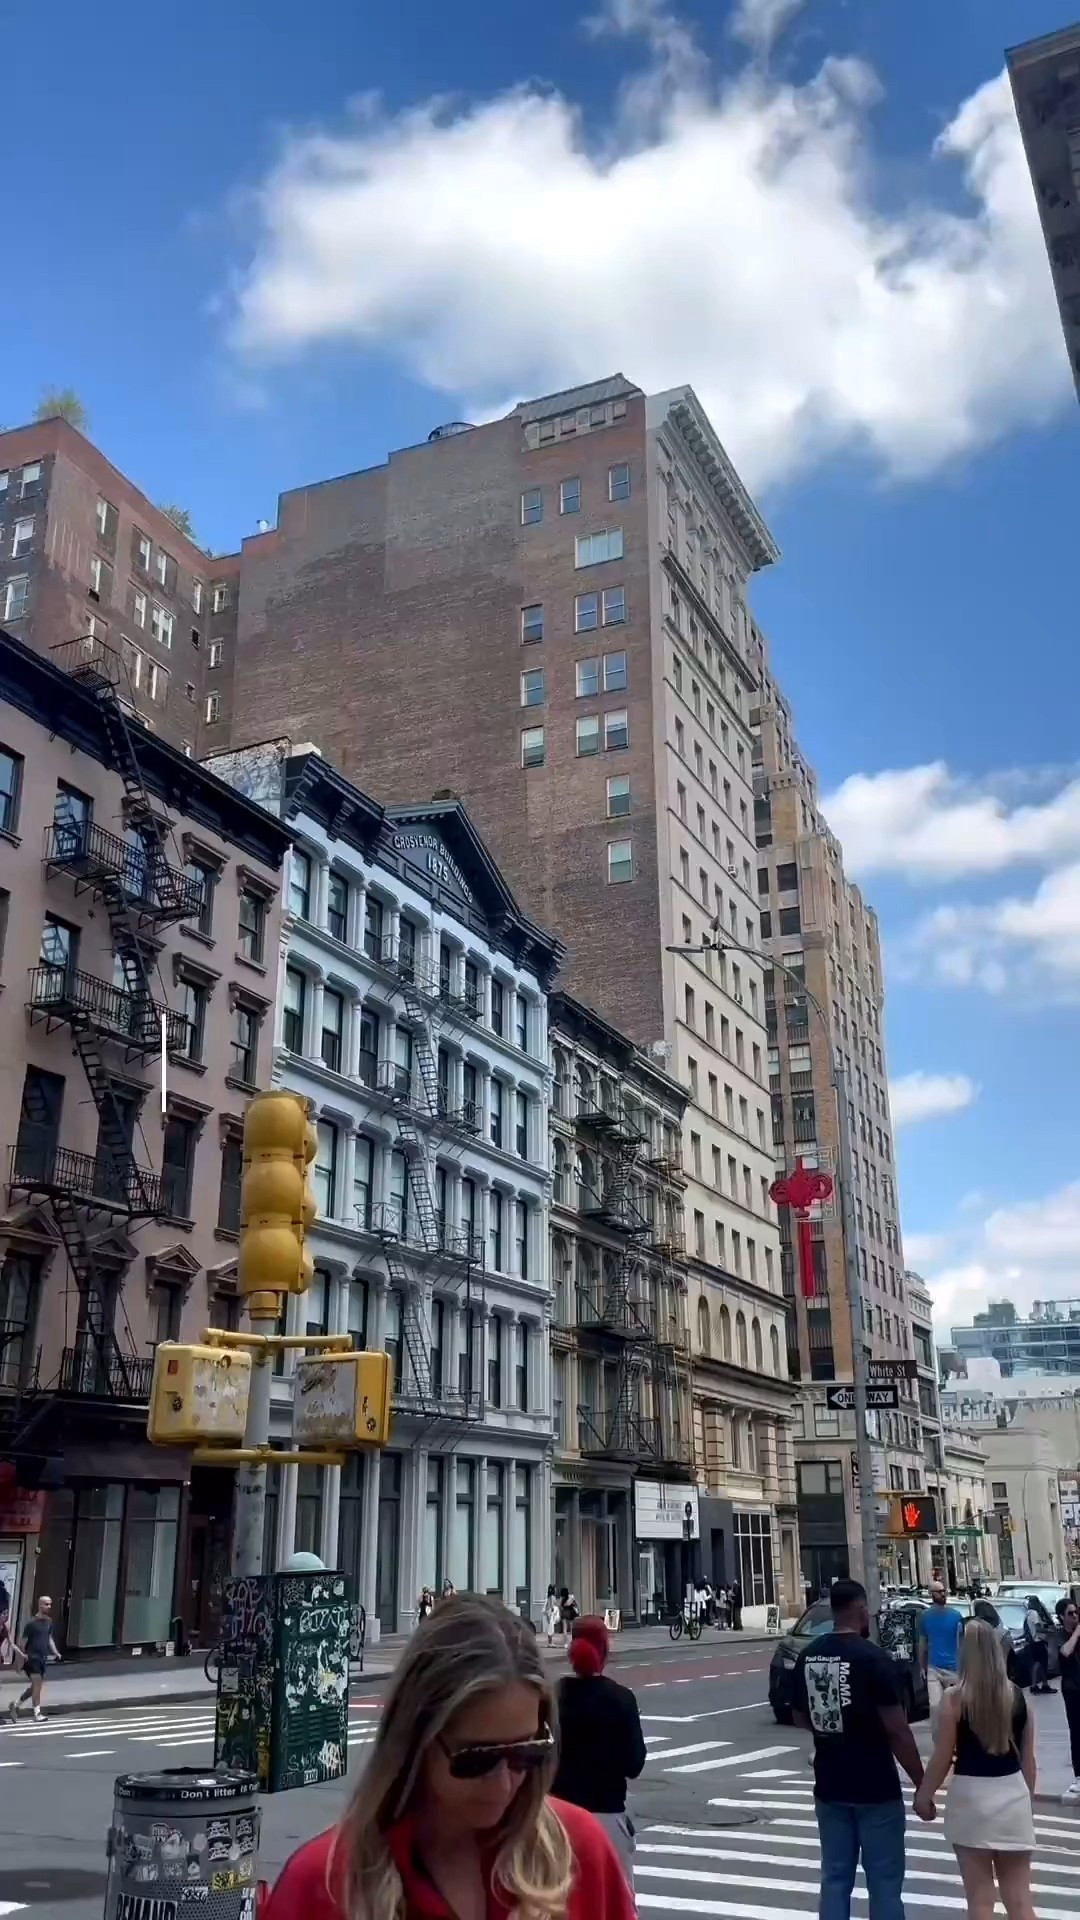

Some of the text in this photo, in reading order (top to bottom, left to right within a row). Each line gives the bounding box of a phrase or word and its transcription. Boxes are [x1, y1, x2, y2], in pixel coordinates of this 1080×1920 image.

[392, 835, 473, 904] GROSVENOR BUILDINGS
[870, 1364, 906, 1377] White St
[868, 1391, 888, 1403] WAY
[840, 1661, 852, 1707] MoMA
[180, 1789, 210, 1799] Don't
[214, 1787, 236, 1797] litter
